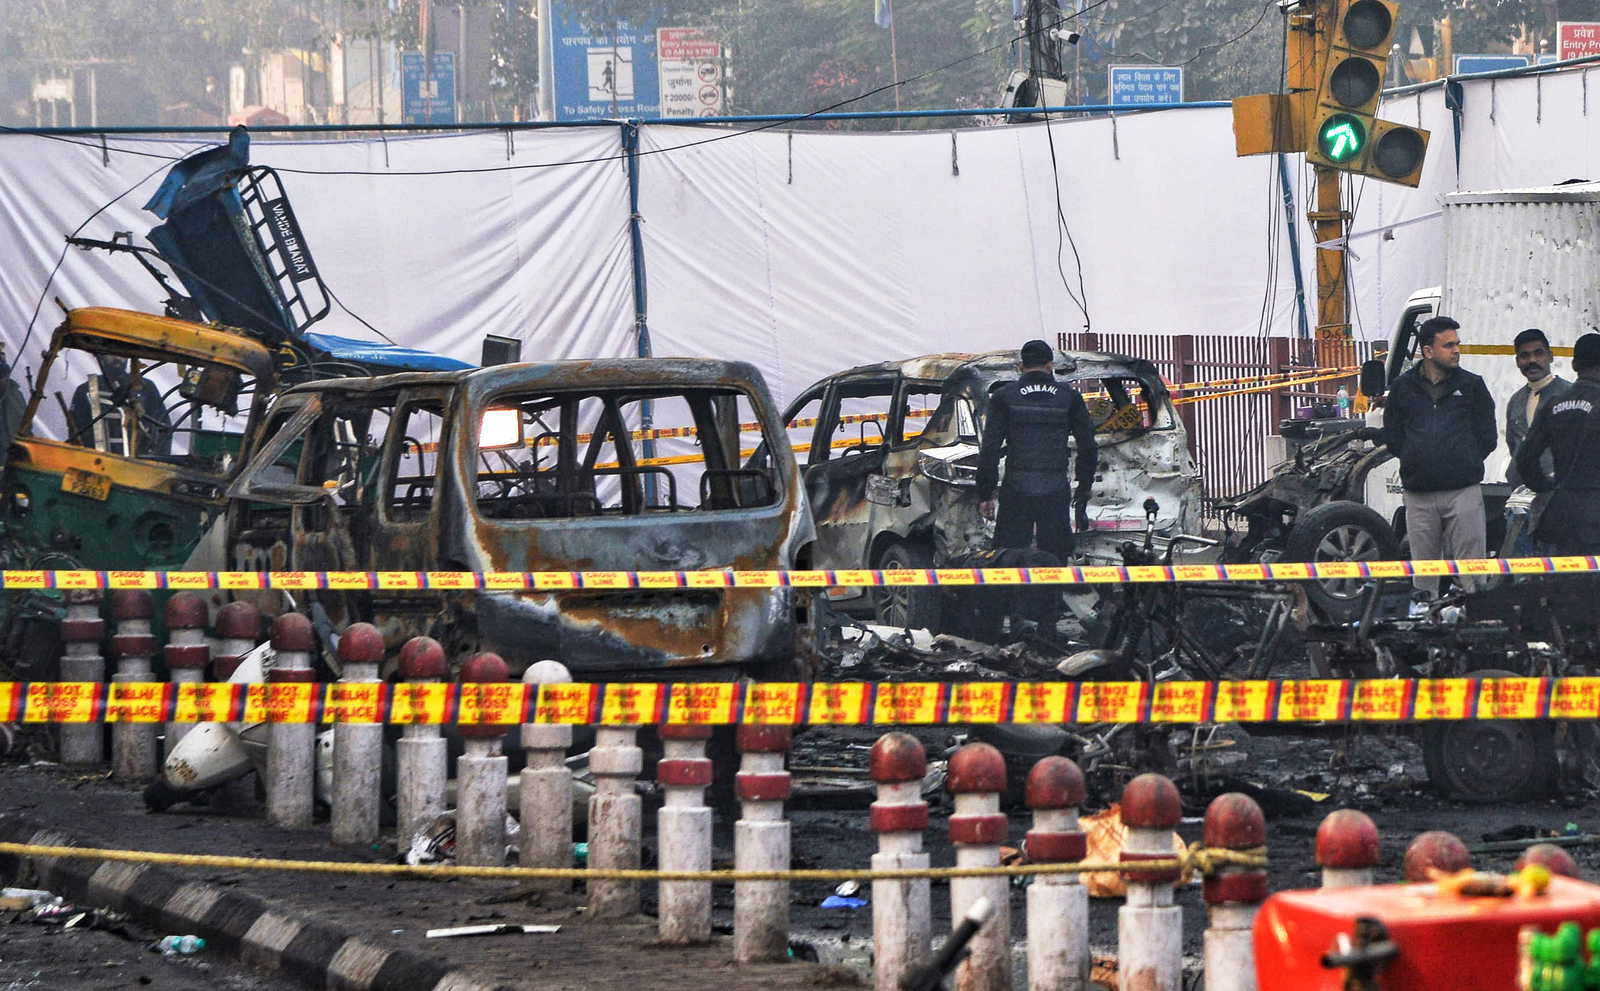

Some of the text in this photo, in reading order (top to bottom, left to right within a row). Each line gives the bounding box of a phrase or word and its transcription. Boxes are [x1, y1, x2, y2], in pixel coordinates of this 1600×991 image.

[1574, 26, 1594, 39] प्रवेश
[1563, 40, 1587, 51] Entry
[563, 106, 576, 114] To
[578, 104, 604, 115] Safely
[667, 107, 695, 116] Penalty
[272, 203, 293, 237] VANDE
[170, 576, 206, 584] POLICE
[939, 573, 971, 581] POLICE
[30, 685, 81, 695] DO NOT
[249, 685, 299, 696] DO NOT
[463, 686, 512, 696] DO NOT
[671, 686, 720, 697] DO NOT
[879, 686, 925, 696] DO NOT
[1083, 685, 1128, 695] DO NOT
[1283, 684, 1328, 694] DO NOT
[1482, 682, 1527, 692] DO NOT
[33, 696, 78, 707] CROSS
[251, 697, 296, 708] CROSS
[675, 698, 717, 709] CROSS
[881, 698, 923, 708] CROSS
[1084, 697, 1126, 707] CROSS
[1285, 695, 1325, 705] CROSS
[1484, 693, 1524, 703] CROSS
[465, 699, 508, 709] CROSS
[1154, 703, 1198, 715] POLICE
[1352, 702, 1397, 713] POLICE
[1491, 704, 1519, 715] LINE
[1551, 699, 1595, 711] POLICE
[40, 709, 71, 720] LINE
[108, 705, 158, 717] POLICE
[258, 710, 289, 720] LINE
[325, 707, 375, 719] POLICE
[472, 710, 502, 721] LINE
[538, 707, 584, 718] POLICE
[682, 710, 711, 721] LINE
[746, 706, 792, 717] POLICE
[888, 709, 915, 720] LINE
[951, 704, 996, 716] POLICE
[1092, 708, 1117, 719] LINE
[1292, 707, 1318, 718] LINE
